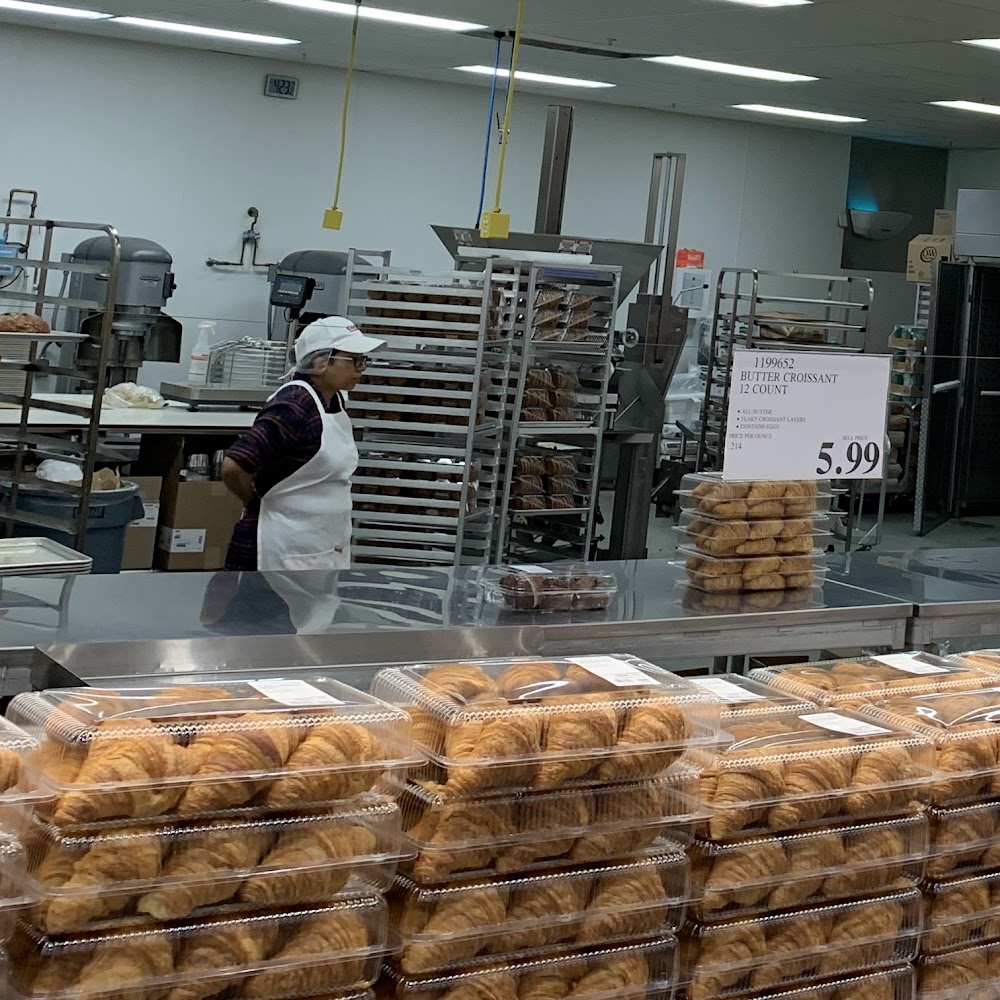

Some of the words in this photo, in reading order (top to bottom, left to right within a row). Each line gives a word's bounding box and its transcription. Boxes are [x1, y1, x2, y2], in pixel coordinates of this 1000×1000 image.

[754, 357, 795, 369] 1199652
[740, 371, 780, 382] BUTTER
[783, 372, 838, 384] CROISSANT
[739, 383, 750, 394] 12
[752, 384, 788, 395] COUNT
[816, 441, 880, 475] 5.99
